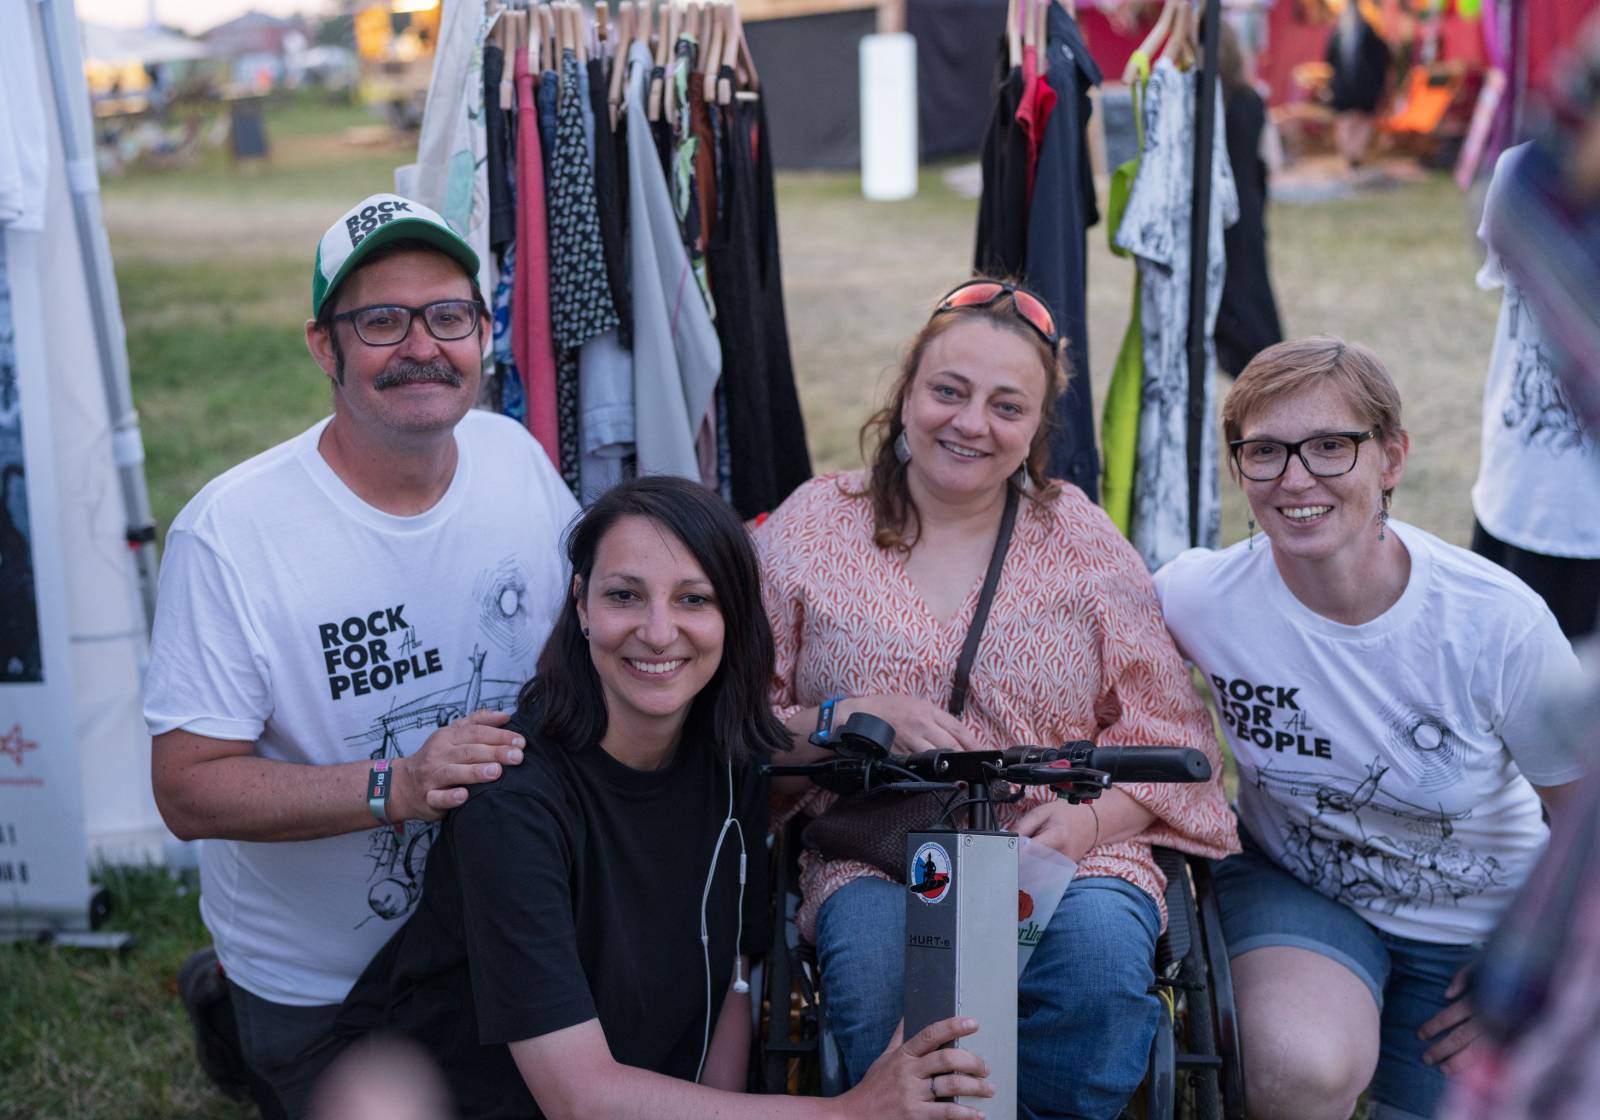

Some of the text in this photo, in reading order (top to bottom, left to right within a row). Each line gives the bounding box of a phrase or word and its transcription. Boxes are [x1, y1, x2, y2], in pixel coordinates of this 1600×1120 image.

[346, 201, 413, 229] ROCK
[350, 213, 393, 239] FOR
[319, 603, 409, 649] ROCK
[324, 639, 390, 675] FOR
[329, 648, 443, 700] PEOPLE
[1210, 673, 1300, 711] ROCK
[1223, 710, 1332, 760] PEOPLE
[377, 773, 385, 785] KB
